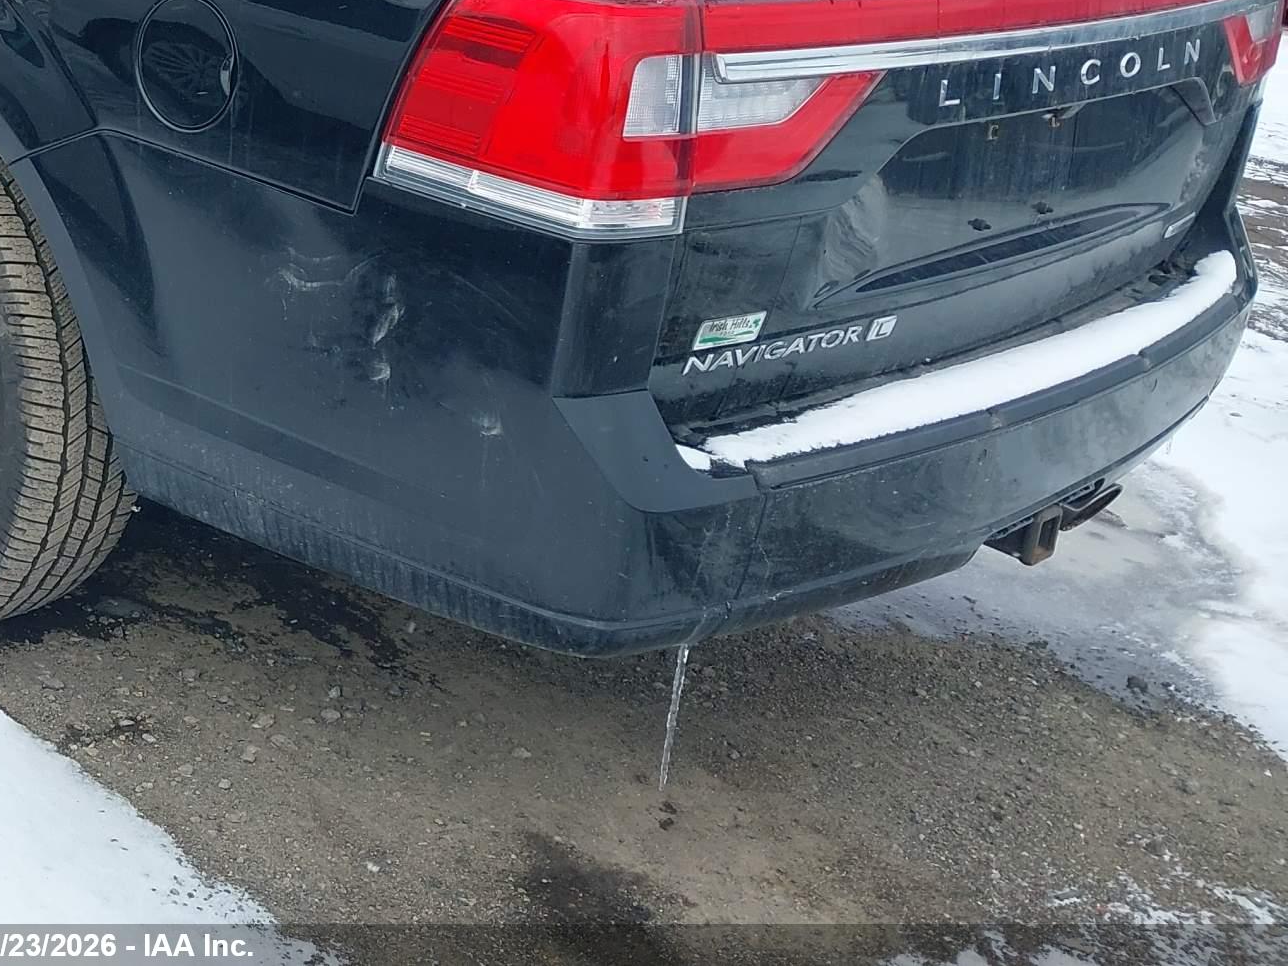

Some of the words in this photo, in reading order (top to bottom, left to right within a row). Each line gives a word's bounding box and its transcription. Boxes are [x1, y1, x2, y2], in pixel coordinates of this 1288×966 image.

[938, 38, 1201, 107] LINCOLN
[682, 325, 863, 376] NAVIGATOR
[870, 316, 896, 339] L
